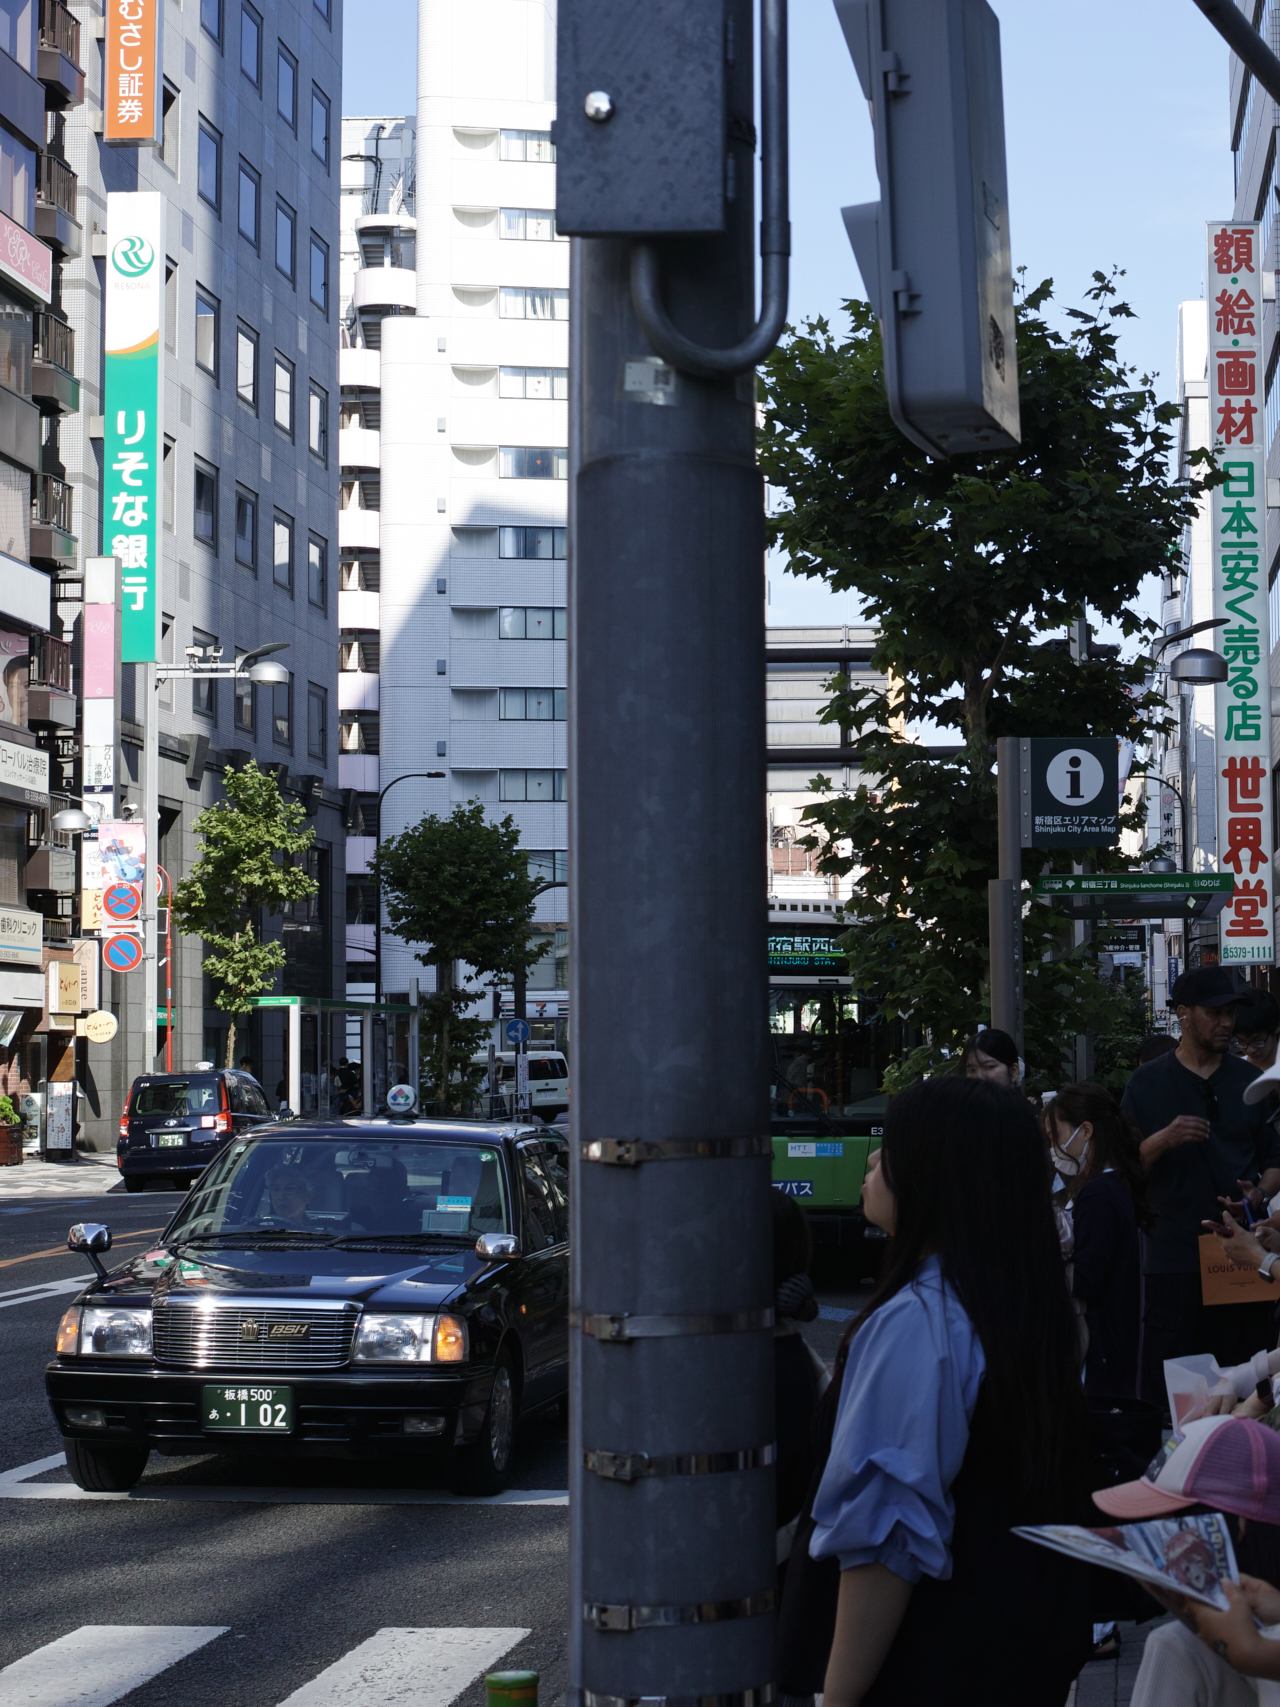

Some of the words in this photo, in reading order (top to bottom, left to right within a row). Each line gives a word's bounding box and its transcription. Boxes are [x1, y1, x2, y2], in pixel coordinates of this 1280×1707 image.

[117, 0, 145, 124] むさし証券
[114, 282, 150, 290] RESONA
[111, 410, 148, 611] りそな銀行
[1222, 459, 1263, 743] 日本一安く売る店
[0, 744, 47, 777] ローバル治療院
[1034, 815, 1117, 825] 新宿区エリアマップ
[1034, 825, 1066, 833] Shinjuku
[1067, 825, 1081, 833] City
[1082, 825, 1100, 833] Area
[1101, 825, 1116, 834] Map
[1221, 756, 1269, 937] 世界堂
[1081, 880, 1118, 889] 新宿三丁目
[1, 917, 37, 936] 歯科クリニック
[814, 957, 836, 965] STA.
[790, 1144, 808, 1152] HTT
[1208, 1265, 1235, 1274] LOUIS
[270, 1324, 308, 1334] BSH
[208, 1408, 220, 1421] あ
